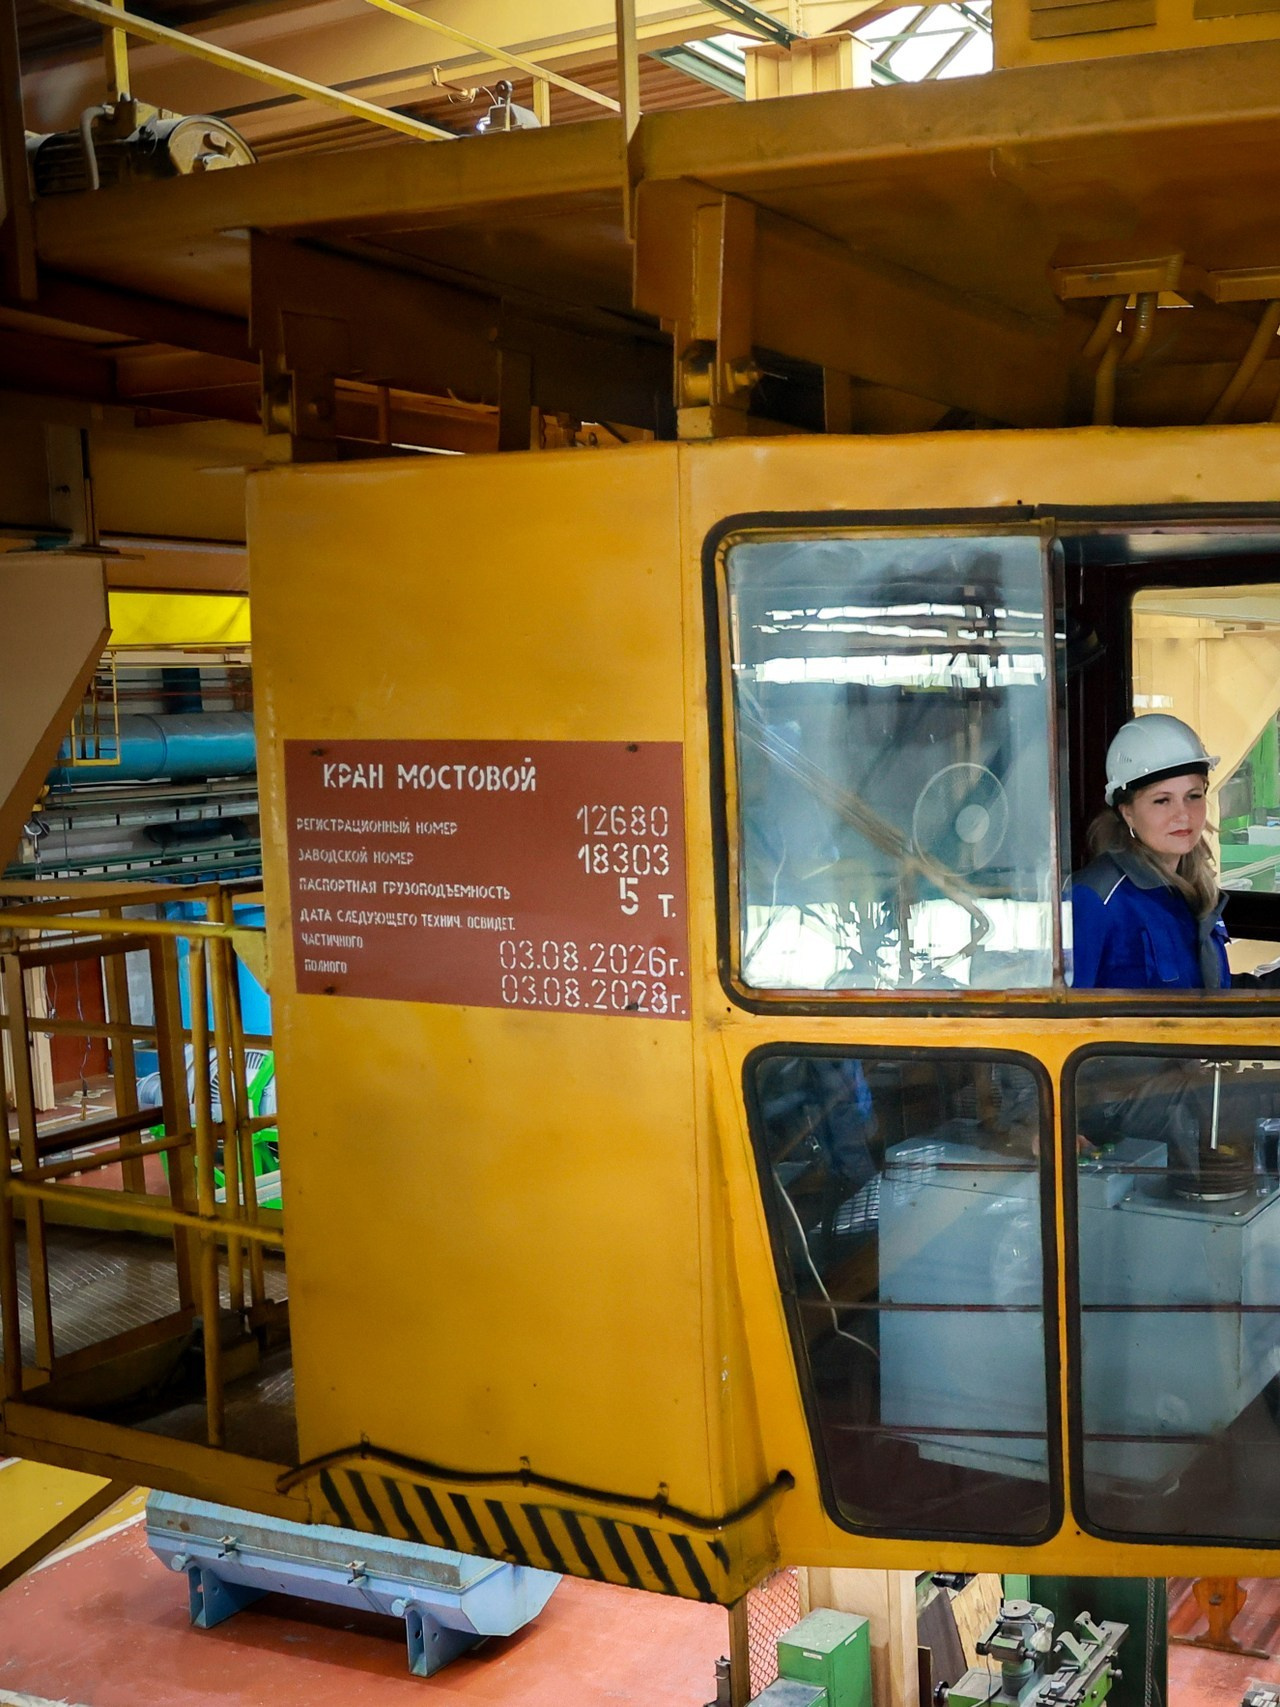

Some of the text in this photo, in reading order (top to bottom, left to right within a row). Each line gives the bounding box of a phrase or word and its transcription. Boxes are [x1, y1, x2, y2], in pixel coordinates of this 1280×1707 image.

[324, 758, 535, 791] КРАН МОСТОВОЙ
[297, 805, 668, 837] РЕГИСТРАЦИОННЫЙ НОМЕР 12680
[299, 843, 670, 876] ЗАВОДСКОЙ НОМЕР 18303
[300, 878, 376, 893] ПАСПОРТНАЯ
[383, 881, 510, 900] ГРУЗОПОДЪЕМНОСТЬ
[619, 877, 639, 915] 5
[300, 908, 515, 931] ДАТА СЛЕДУЮЩЕГО ТЕХНИЧ. ОСВИДЕТ.
[302, 933, 363, 948] ЧАСТИЧНОГО
[305, 959, 347, 973] ПОЛНОГО
